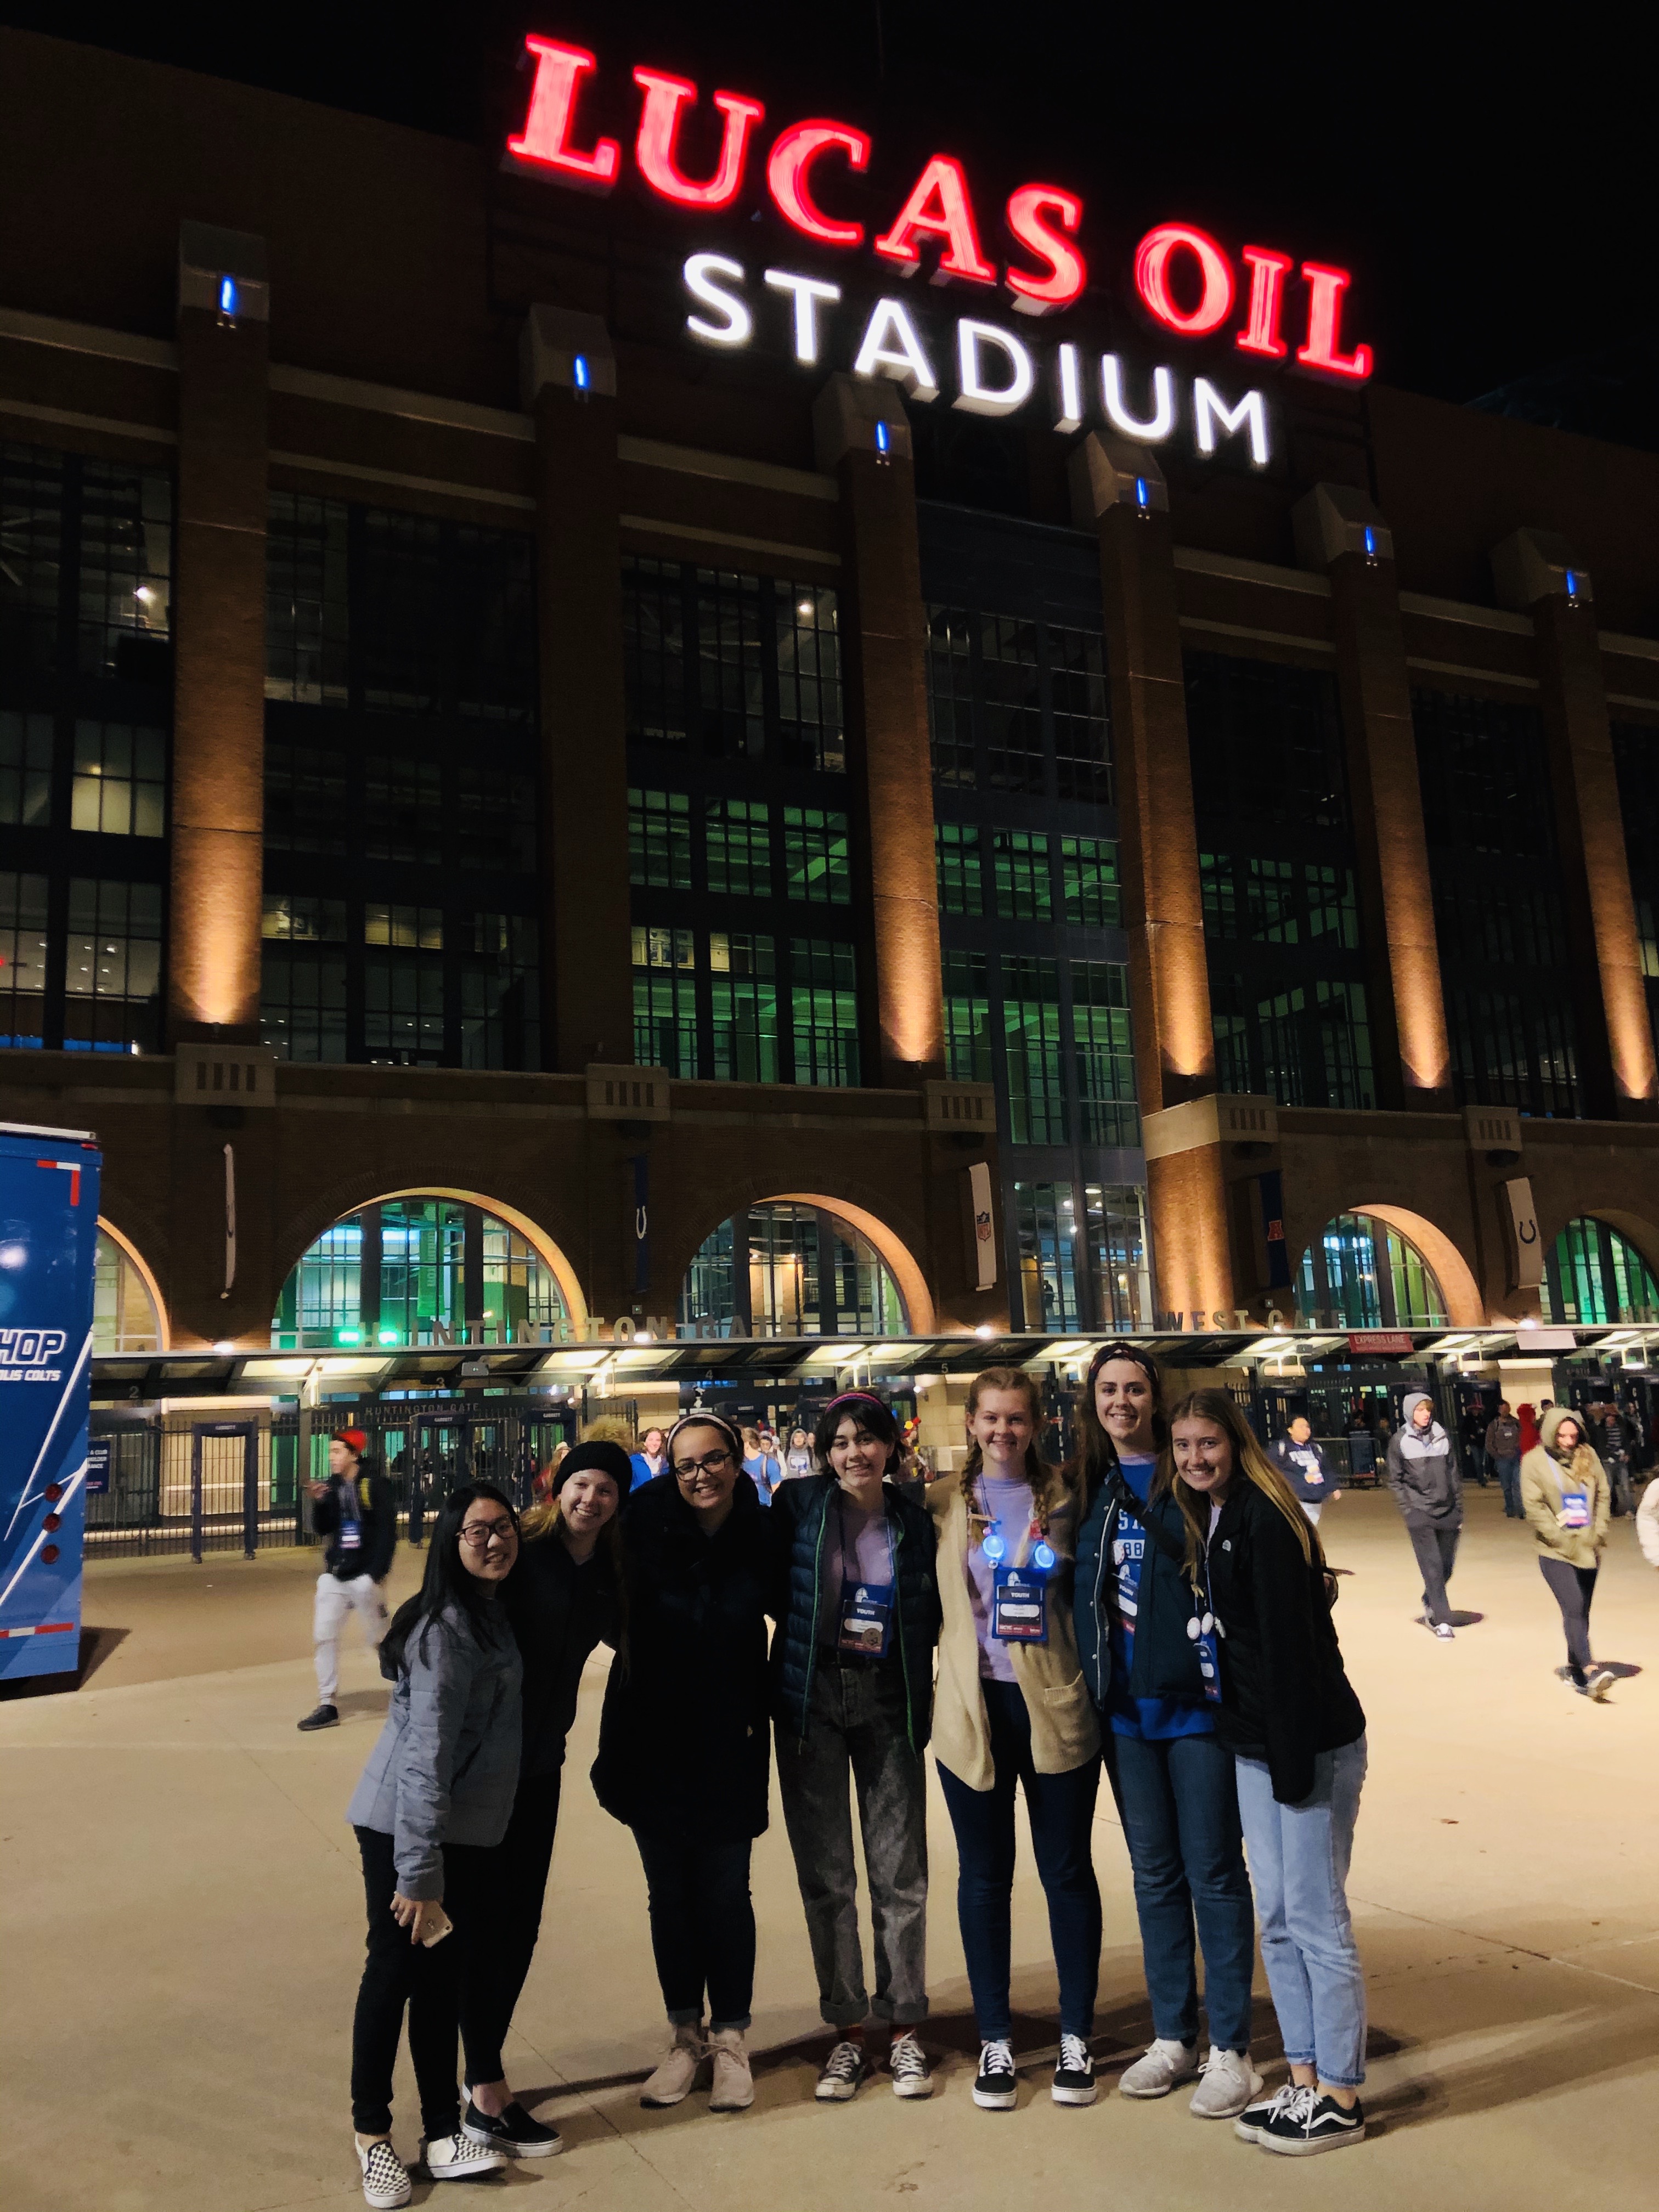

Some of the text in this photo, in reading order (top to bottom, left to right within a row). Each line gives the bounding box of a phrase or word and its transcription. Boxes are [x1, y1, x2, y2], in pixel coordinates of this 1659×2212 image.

[506, 34, 1373, 379] LUCAS OIL
[684, 253, 1268, 465] STADIUM
[1155, 1310, 1249, 1331] WEST
[1354, 1334, 1406, 1344] EXPRESS LANE
[941, 1363, 949, 1374] 5
[24, 1370, 61, 1381] COLTS
[436, 1377, 445, 1389] 3
[129, 1386, 139, 1399] 2
[365, 1402, 479, 1415] HUNTINGTON GATE
[856, 1607, 875, 1616] YOUTH
